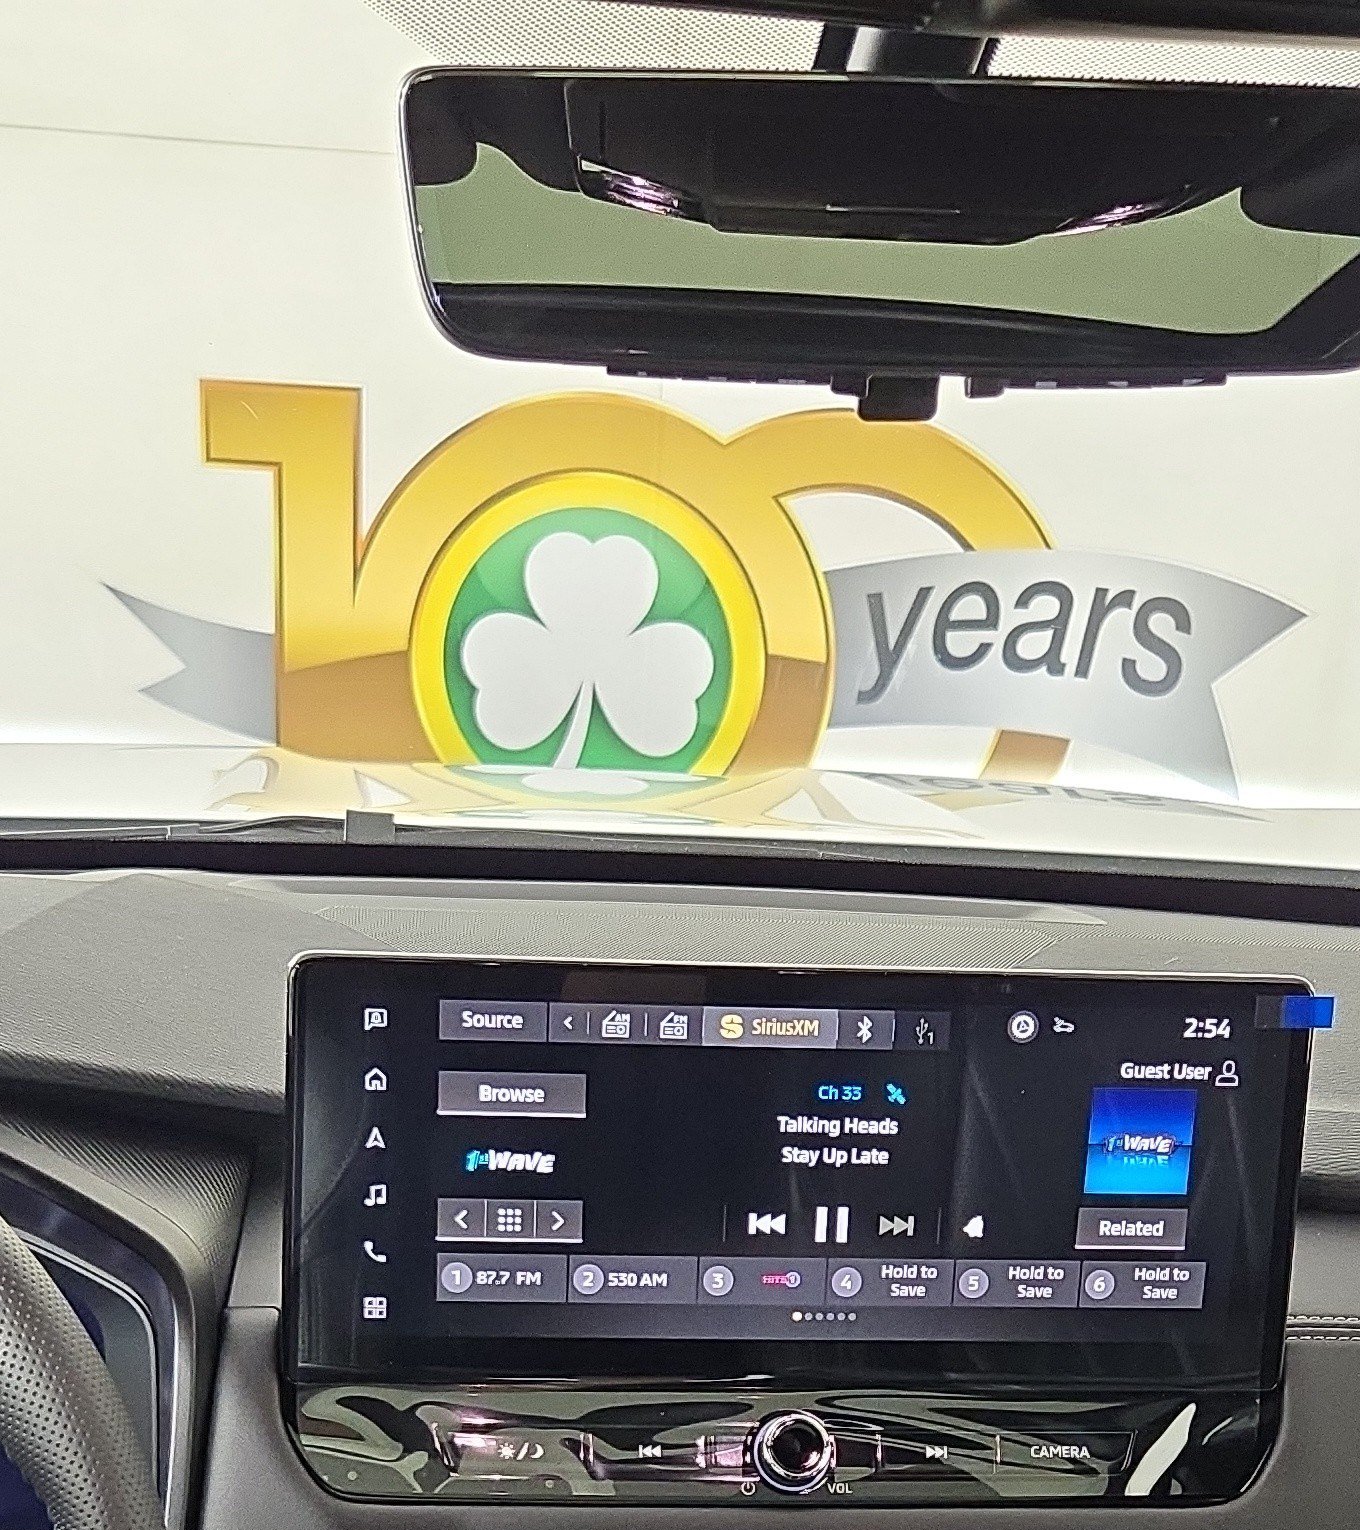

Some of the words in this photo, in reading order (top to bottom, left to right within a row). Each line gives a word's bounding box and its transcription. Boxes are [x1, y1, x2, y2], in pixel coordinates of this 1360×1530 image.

[856, 579, 1193, 705] years
[461, 1010, 524, 1030] Source
[751, 1016, 820, 1037] SiriusXM
[1183, 1017, 1233, 1040] 2:54
[1120, 1062, 1171, 1082] Guest
[1173, 1063, 1213, 1082] User
[478, 1084, 545, 1104] Browse
[818, 1085, 839, 1101] Ch
[841, 1085, 862, 1101] 33
[778, 1116, 840, 1136] Talking
[843, 1117, 899, 1135] Heads
[487, 1150, 556, 1174] WAVE
[781, 1147, 820, 1167] Stay
[823, 1148, 848, 1167] Up
[850, 1148, 889, 1165] Late
[1099, 1220, 1165, 1238] Related
[450, 1268, 462, 1288] 1
[476, 1271, 509, 1288] 87.7
[515, 1271, 542, 1288] FM
[581, 1270, 595, 1289] 2
[608, 1271, 638, 1288] 530
[639, 1271, 668, 1288] AM
[712, 1271, 725, 1290] 3
[839, 1275, 853, 1291] 4
[881, 1264, 917, 1280] Hold
[920, 1265, 938, 1280] to
[968, 1275, 981, 1292] 5
[1008, 1265, 1044, 1281] Hold
[1047, 1266, 1065, 1281] to
[1093, 1276, 1107, 1293] 6
[1134, 1267, 1170, 1282] Hold
[1173, 1267, 1190, 1282] to
[890, 1282, 926, 1298] Save
[1017, 1283, 1054, 1299] Save
[1142, 1284, 1179, 1300] Save
[1030, 1445, 1091, 1459] CAMERA
[827, 1482, 853, 1495] VOL
